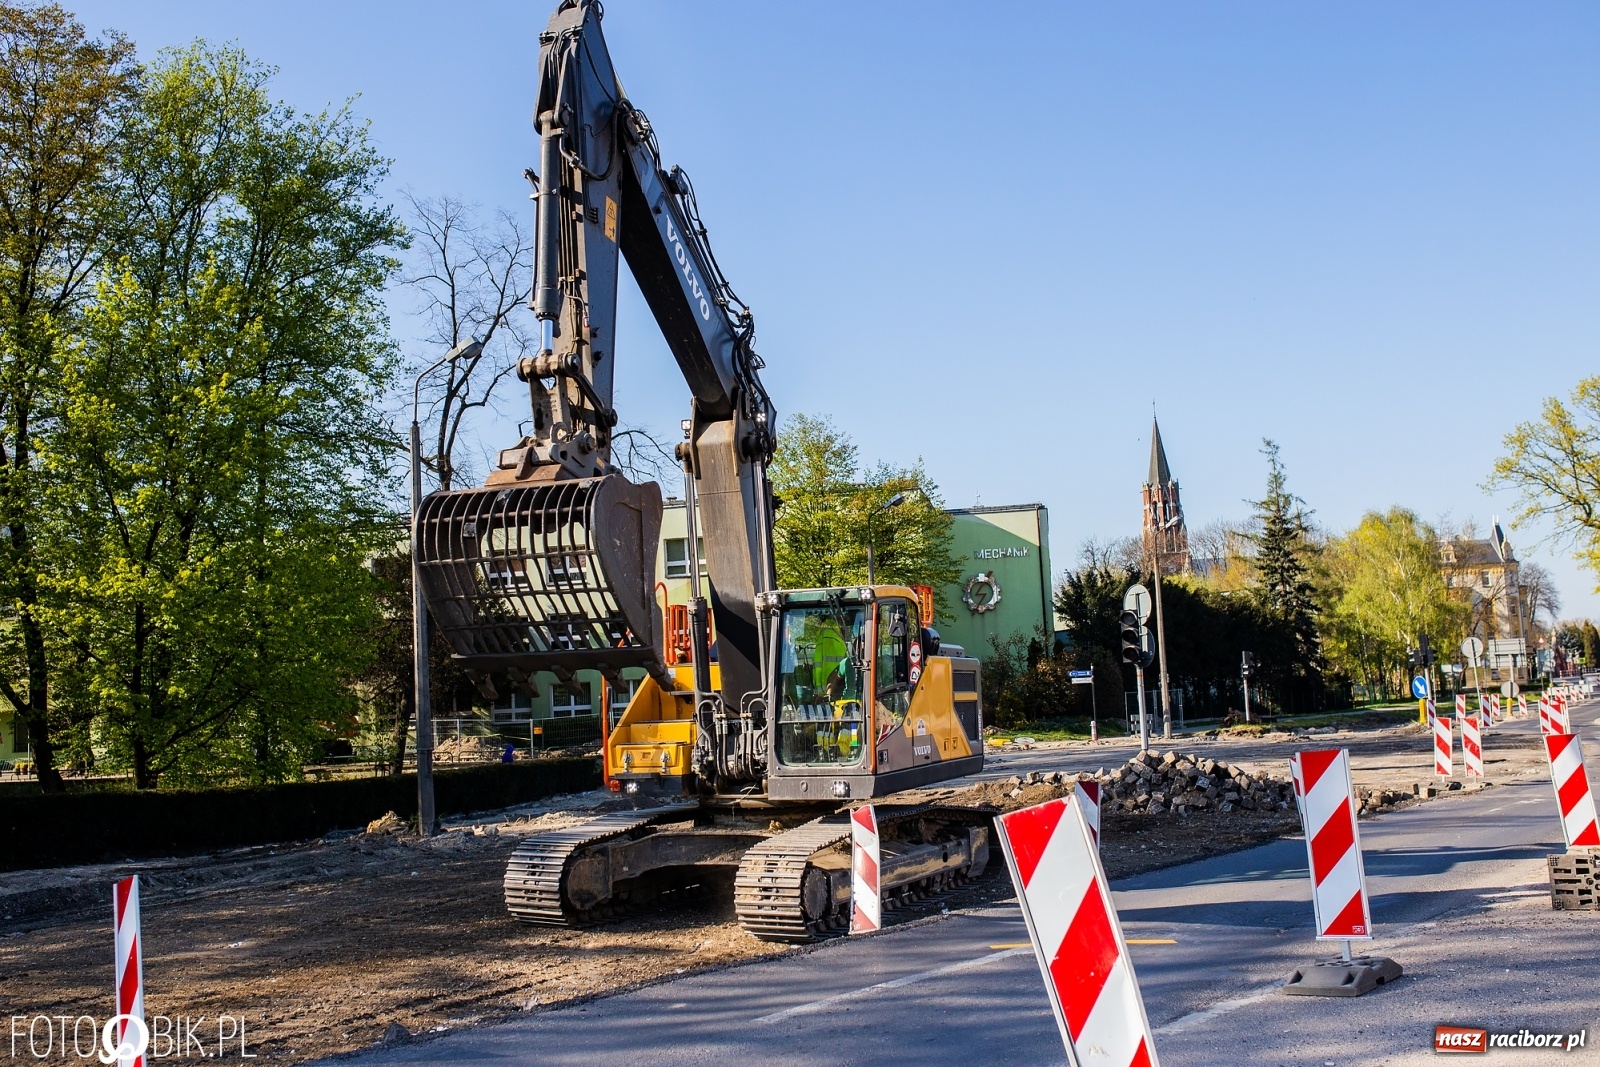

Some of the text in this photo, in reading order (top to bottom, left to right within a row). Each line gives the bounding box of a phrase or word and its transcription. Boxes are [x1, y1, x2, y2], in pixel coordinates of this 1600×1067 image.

[665, 214, 710, 322] VOLVO
[973, 546, 1030, 560] MECHANIK
[913, 745, 932, 756] VOLVO
